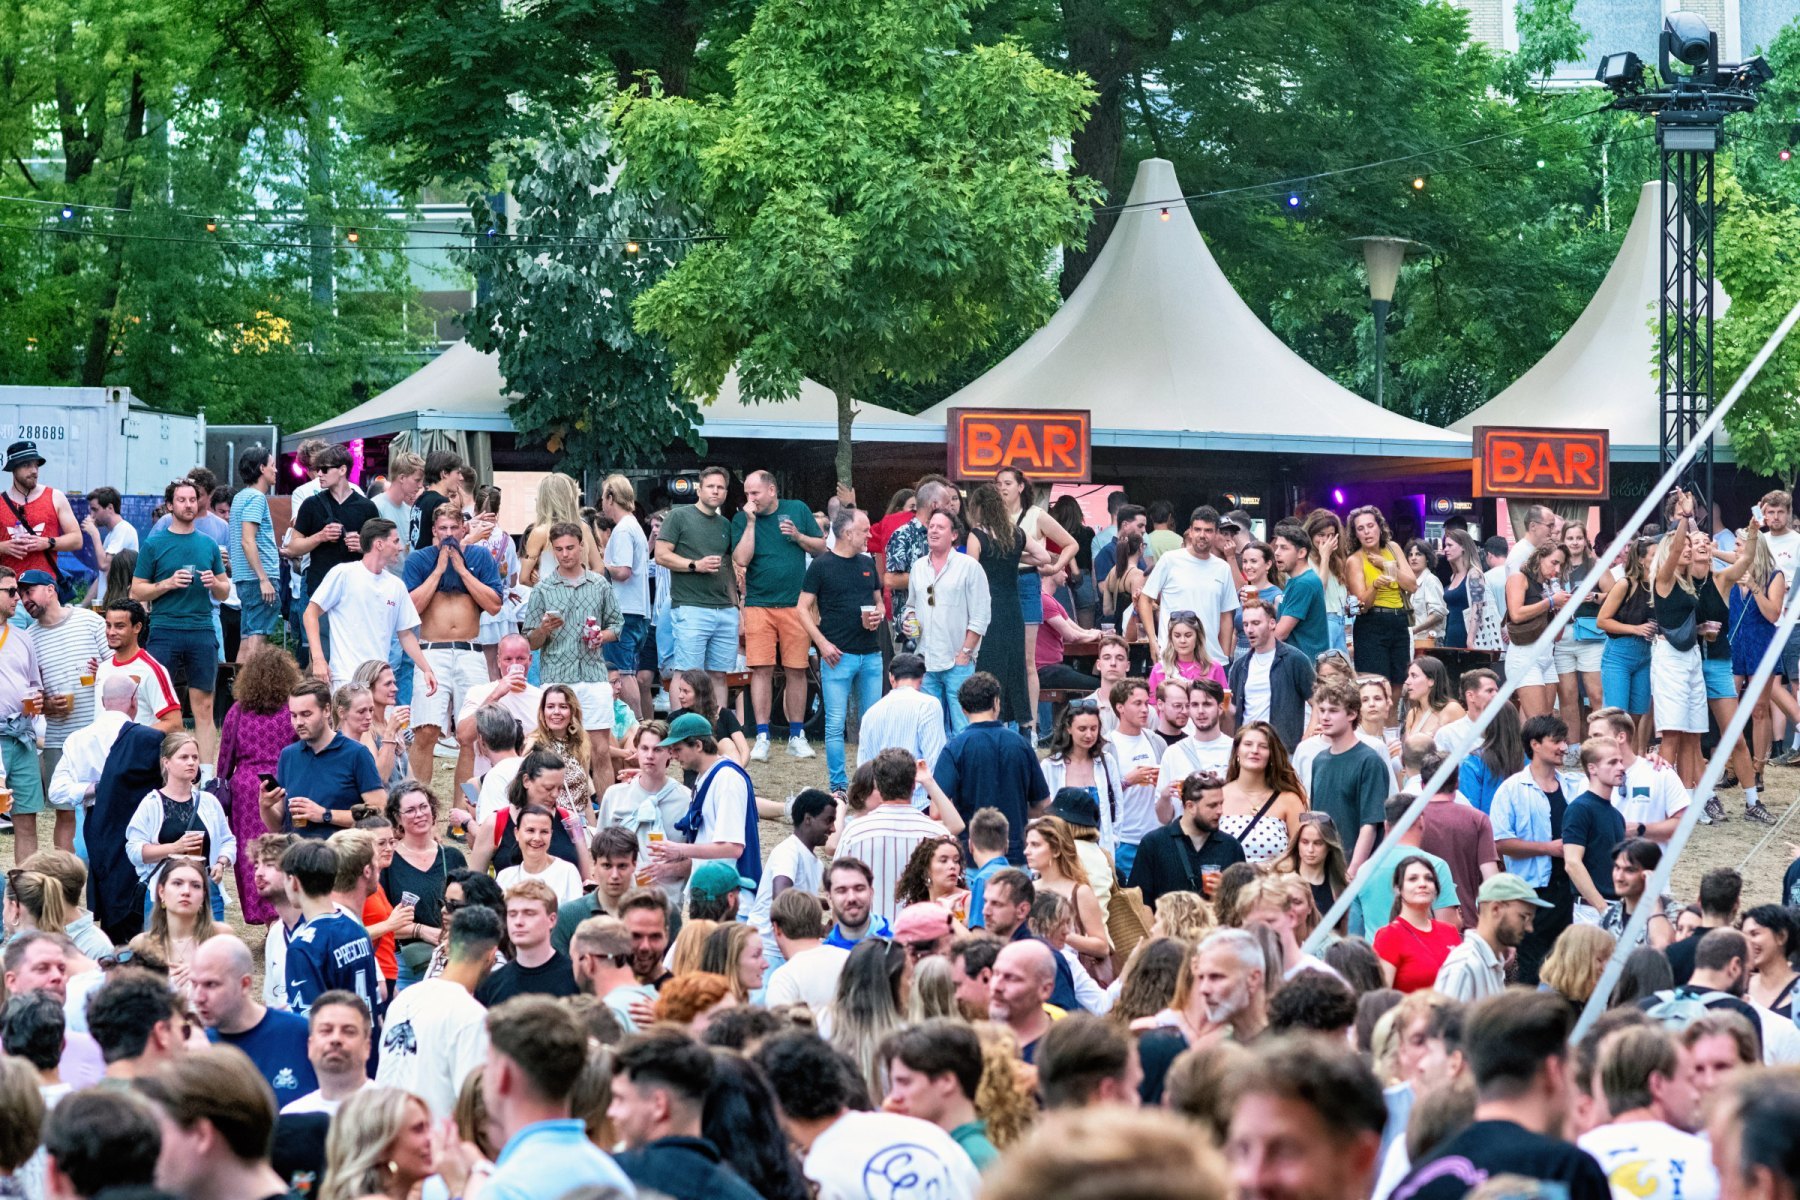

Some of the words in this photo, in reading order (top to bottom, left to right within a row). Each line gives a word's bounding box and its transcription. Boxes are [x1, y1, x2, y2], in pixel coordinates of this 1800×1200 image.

[19, 425, 65, 440] 288689
[967, 423, 1077, 467] BAR
[1492, 440, 1596, 485] BAR
